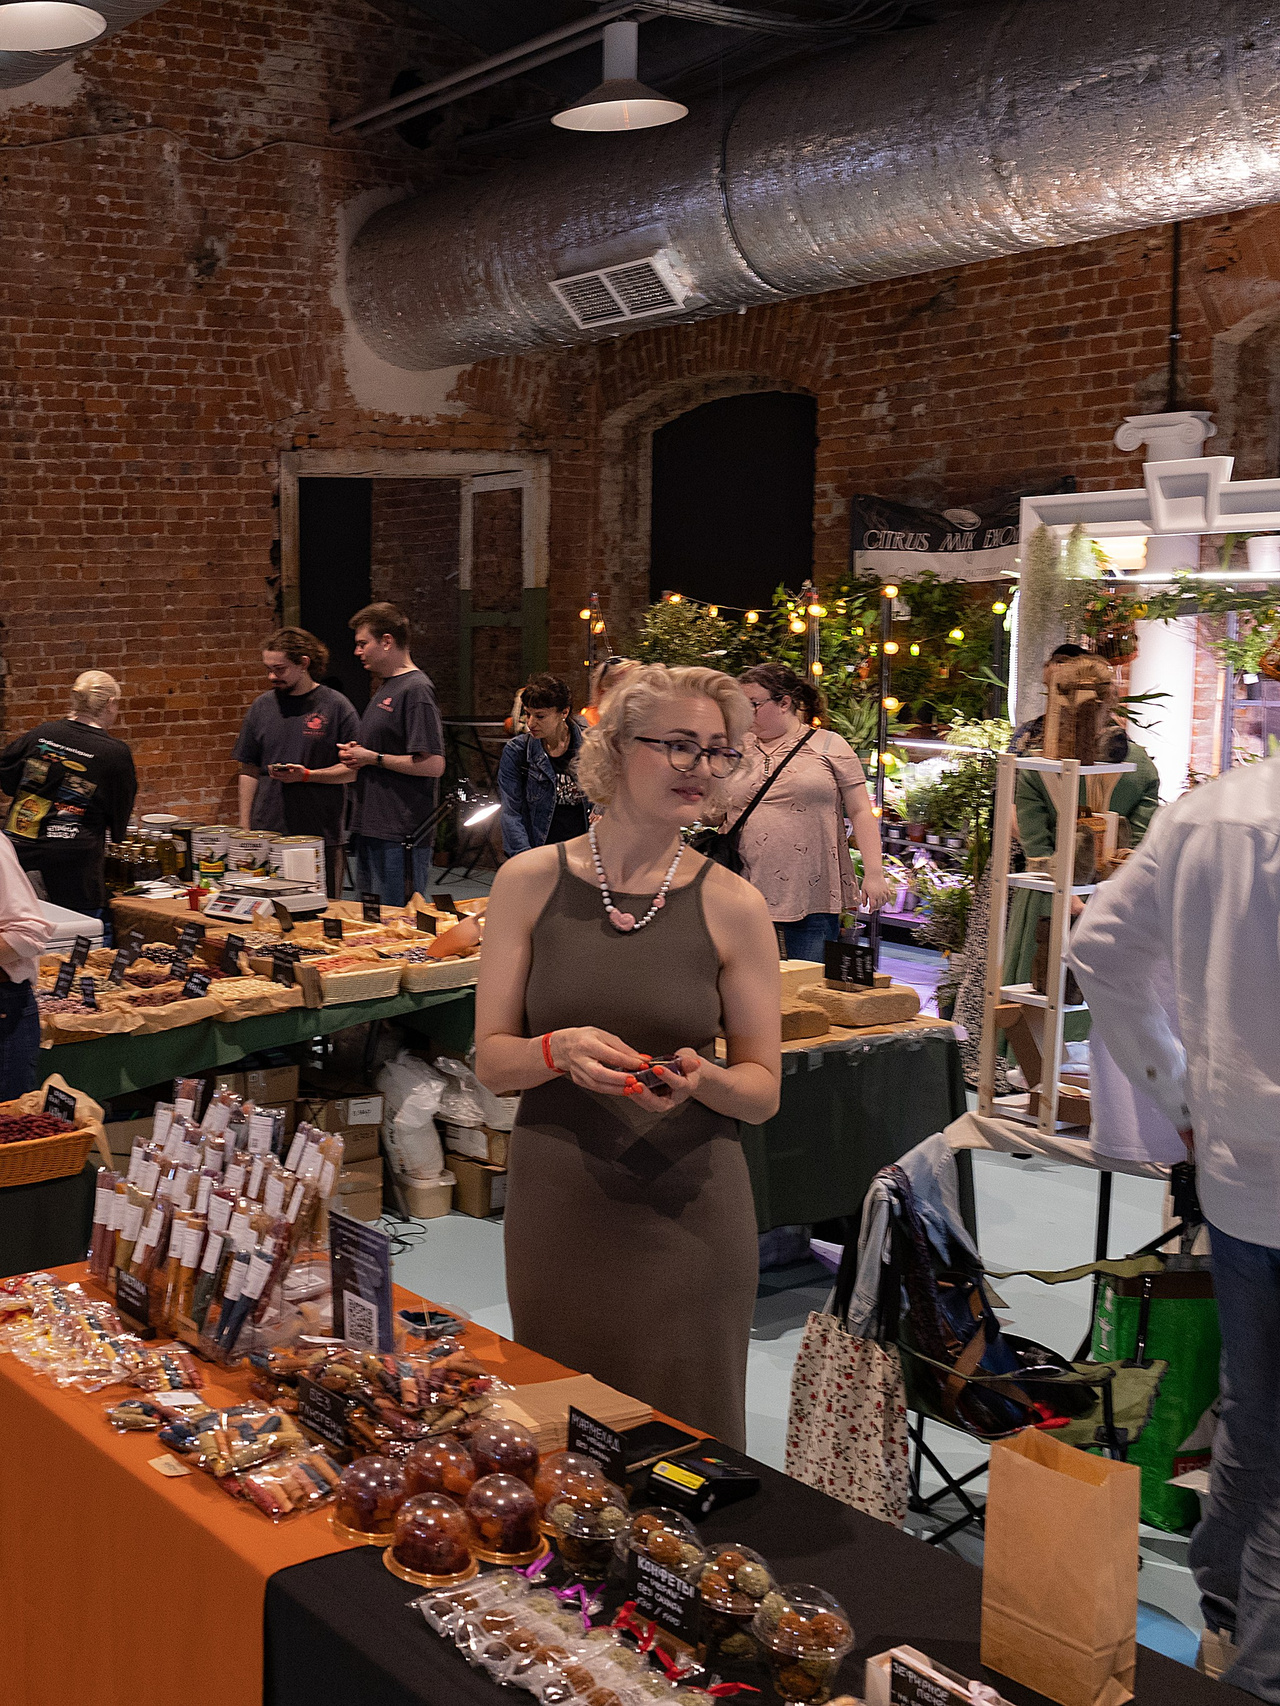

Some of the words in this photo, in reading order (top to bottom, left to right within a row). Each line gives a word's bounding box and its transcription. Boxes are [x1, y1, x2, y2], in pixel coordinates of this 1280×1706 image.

[863, 529, 930, 551] CITRUS
[938, 531, 978, 551] MIX
[637, 1555, 696, 1598] КОНФЕТЫ
[892, 1661, 950, 1701] ЗЕФИРНОЕ
